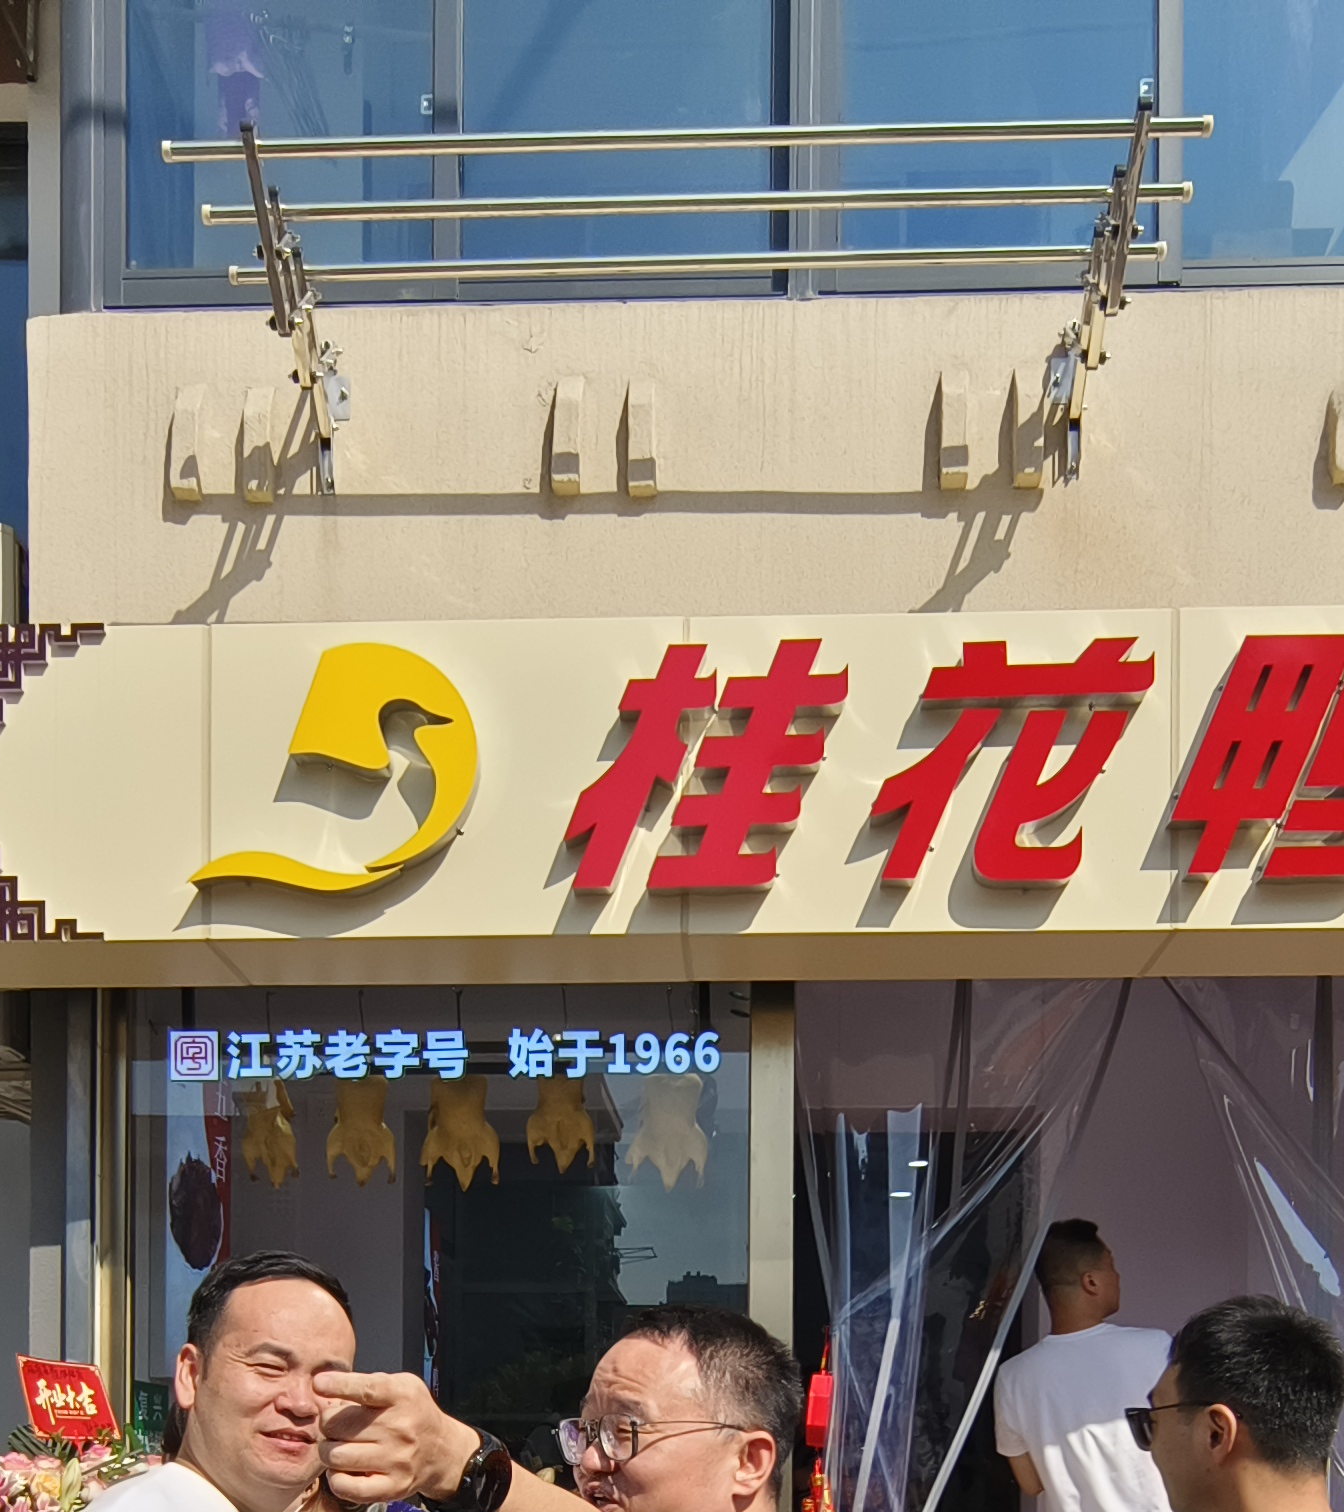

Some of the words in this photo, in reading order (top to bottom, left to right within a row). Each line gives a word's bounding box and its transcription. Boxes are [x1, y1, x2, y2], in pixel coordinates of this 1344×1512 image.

[226, 1028, 469, 1079] 江苏老字号
[507, 1028, 721, 1079] 始于1966
[34, 1378, 98, 1426] 开业大吉
